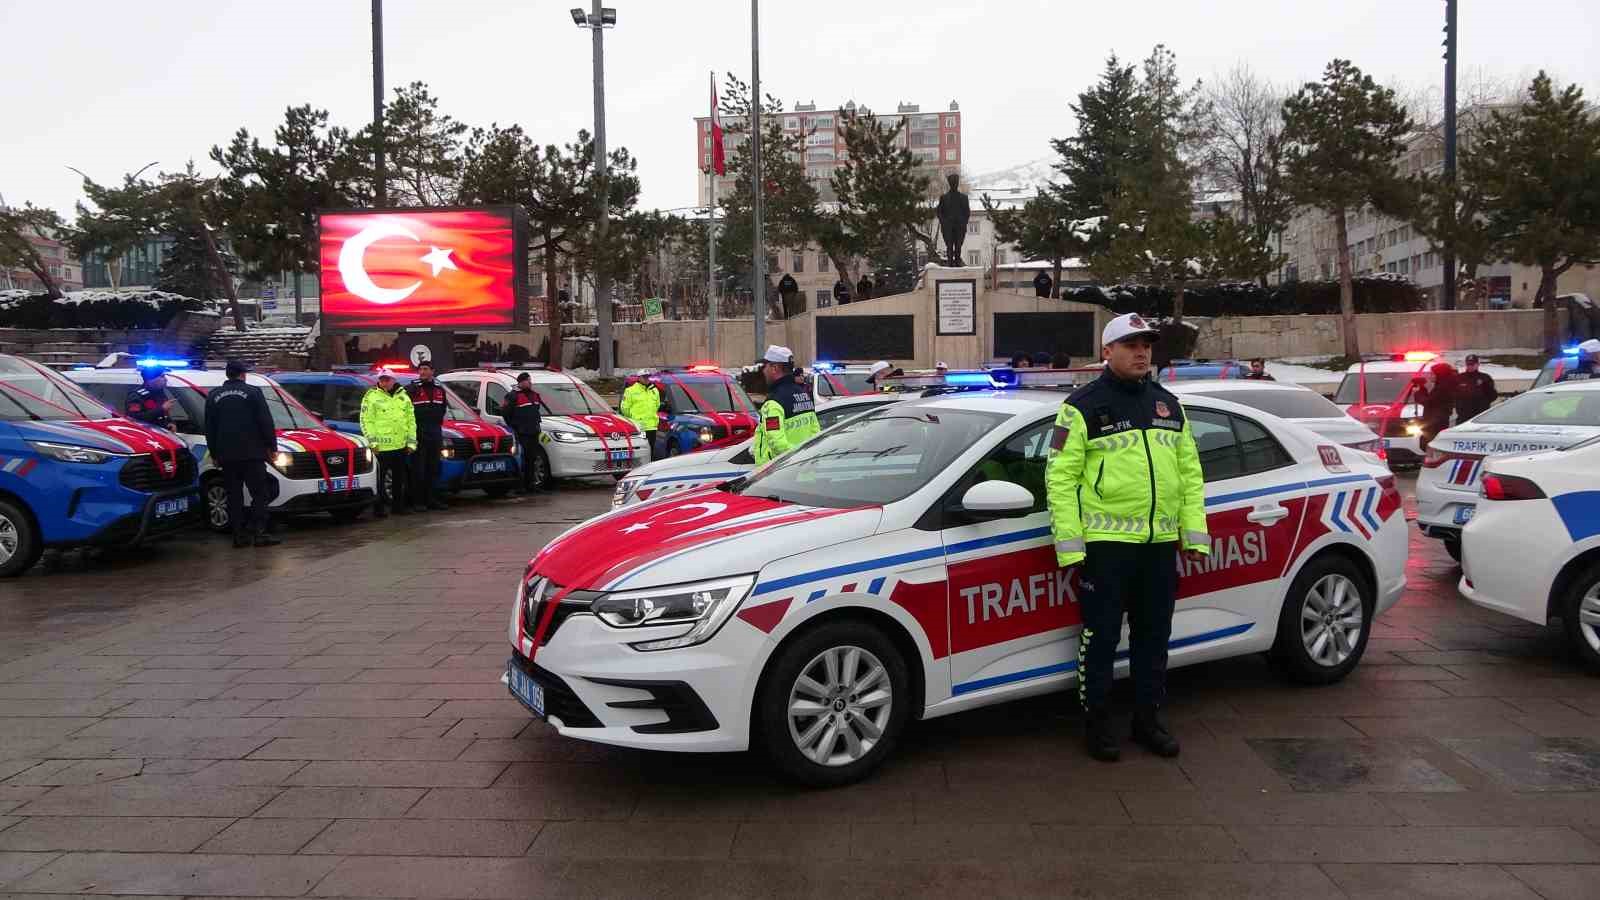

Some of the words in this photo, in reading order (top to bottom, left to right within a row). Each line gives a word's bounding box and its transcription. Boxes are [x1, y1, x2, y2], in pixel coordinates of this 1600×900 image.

[1320, 447, 1341, 465] 112
[1453, 441, 1488, 452] TRAFİK
[1490, 443, 1556, 453] JANDARM
[960, 570, 1079, 625] TRAFİK
